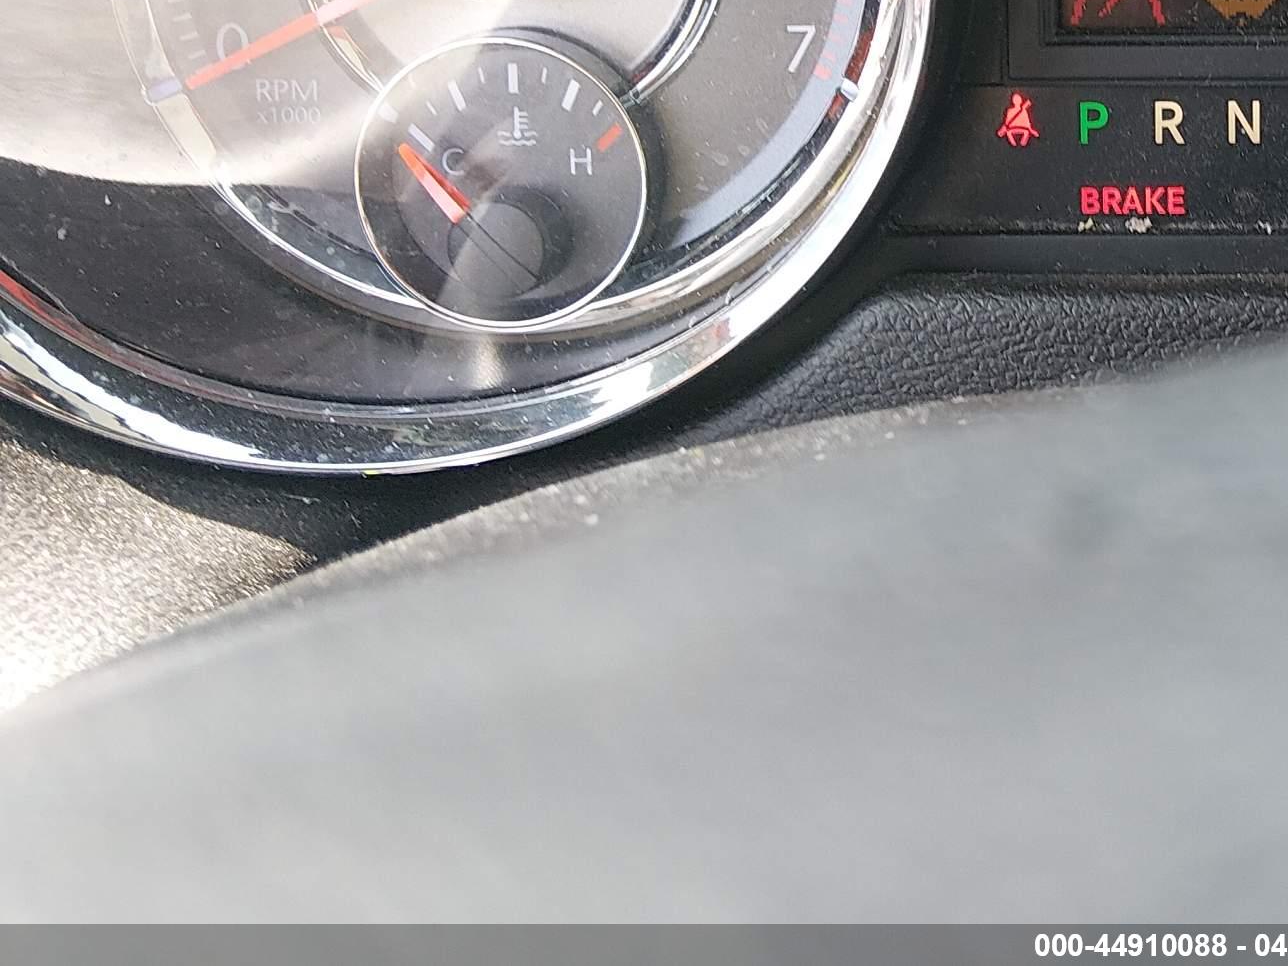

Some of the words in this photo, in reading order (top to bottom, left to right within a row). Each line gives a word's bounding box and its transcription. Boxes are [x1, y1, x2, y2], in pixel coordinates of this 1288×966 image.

[216, 21, 250, 69] 0
[786, 24, 815, 73] 7
[256, 79, 318, 103] RPM
[1079, 102, 1108, 144] P
[1155, 101, 1184, 144] R
[1228, 101, 1261, 144] N
[442, 149, 465, 176] C
[570, 148, 593, 175] H
[1081, 186, 1185, 215] BRAKE
